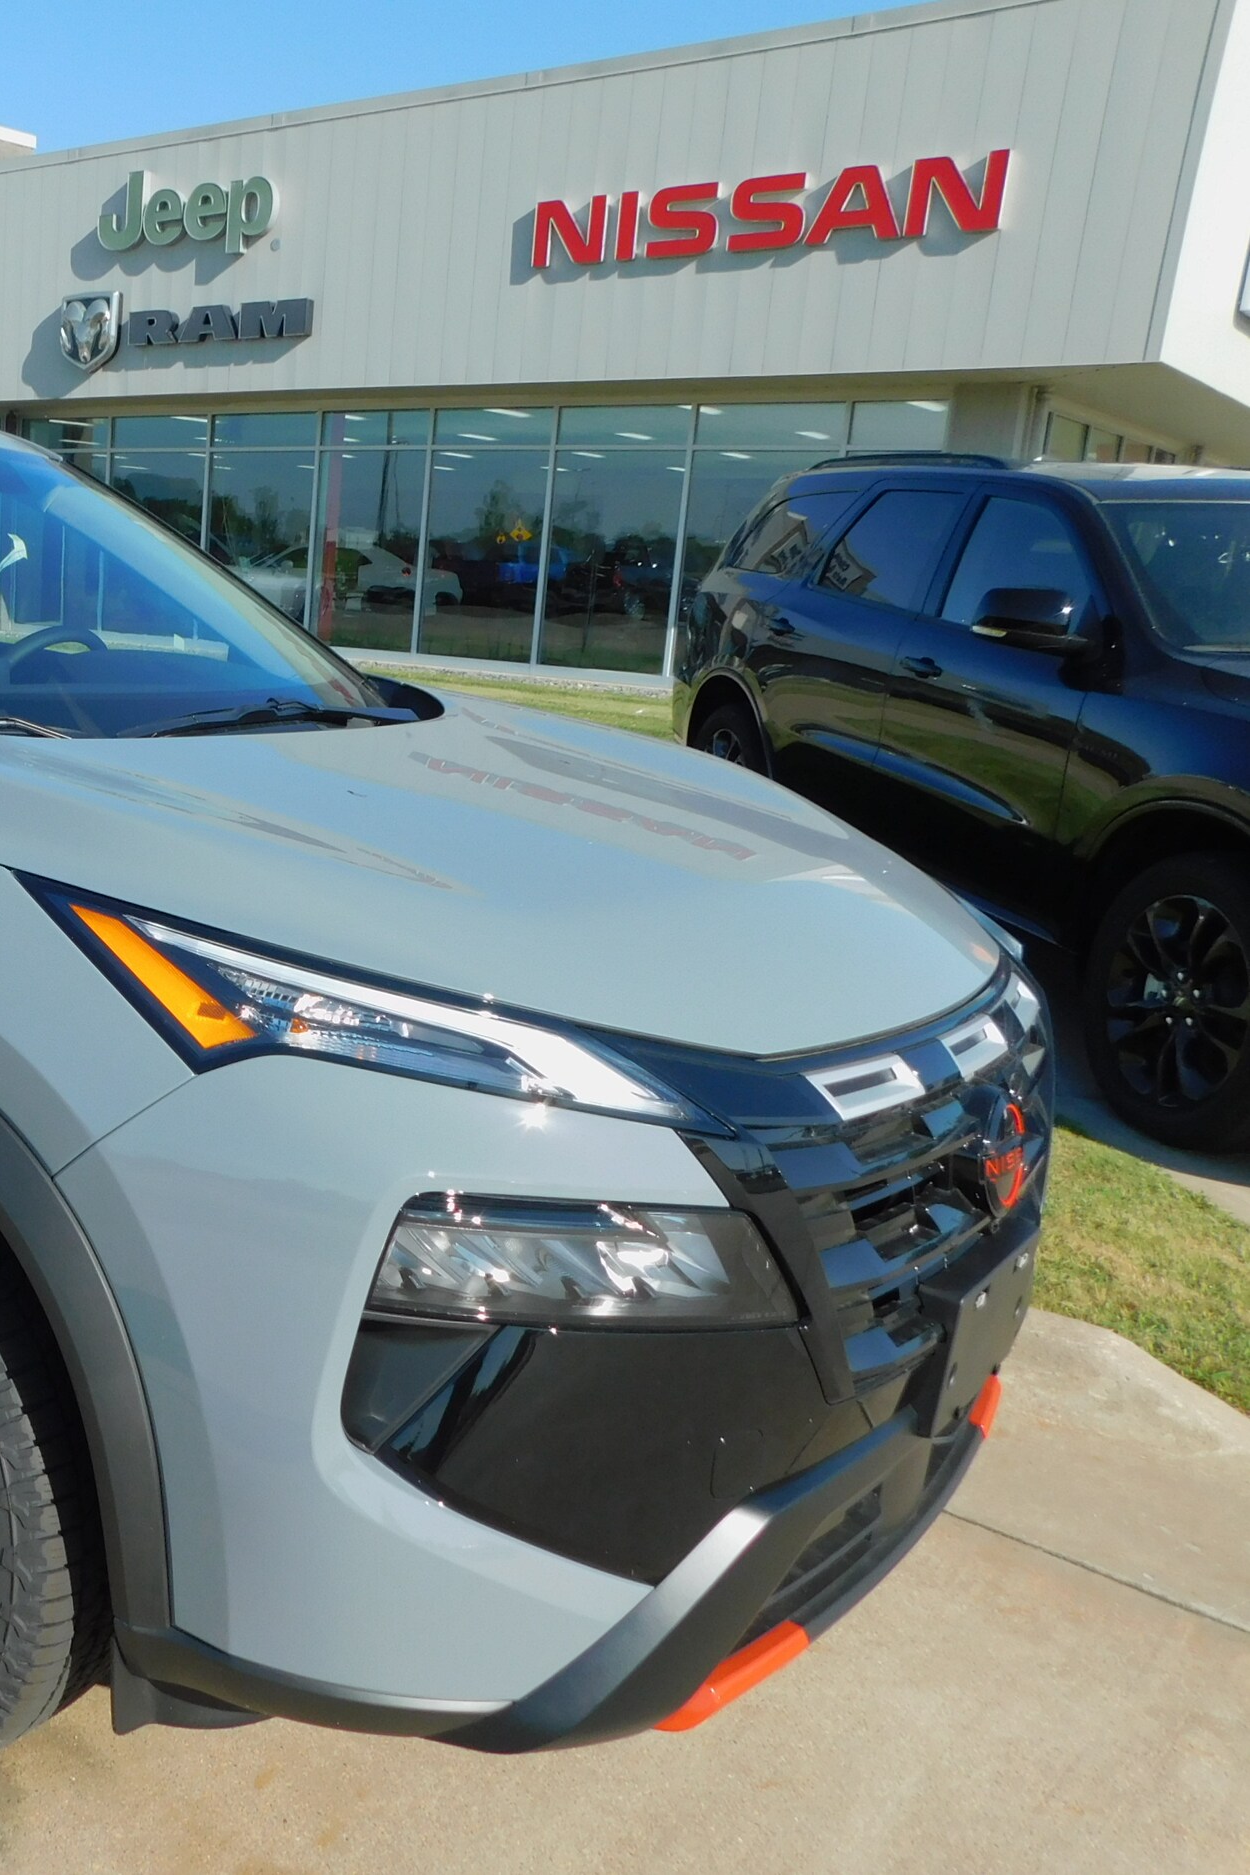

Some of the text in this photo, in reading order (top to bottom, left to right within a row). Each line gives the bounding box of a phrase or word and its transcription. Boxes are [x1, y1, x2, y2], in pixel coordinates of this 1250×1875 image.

[97, 170, 280, 255] Jeep
[531, 148, 1011, 269] NISSAN
[127, 298, 314, 346] RAM
